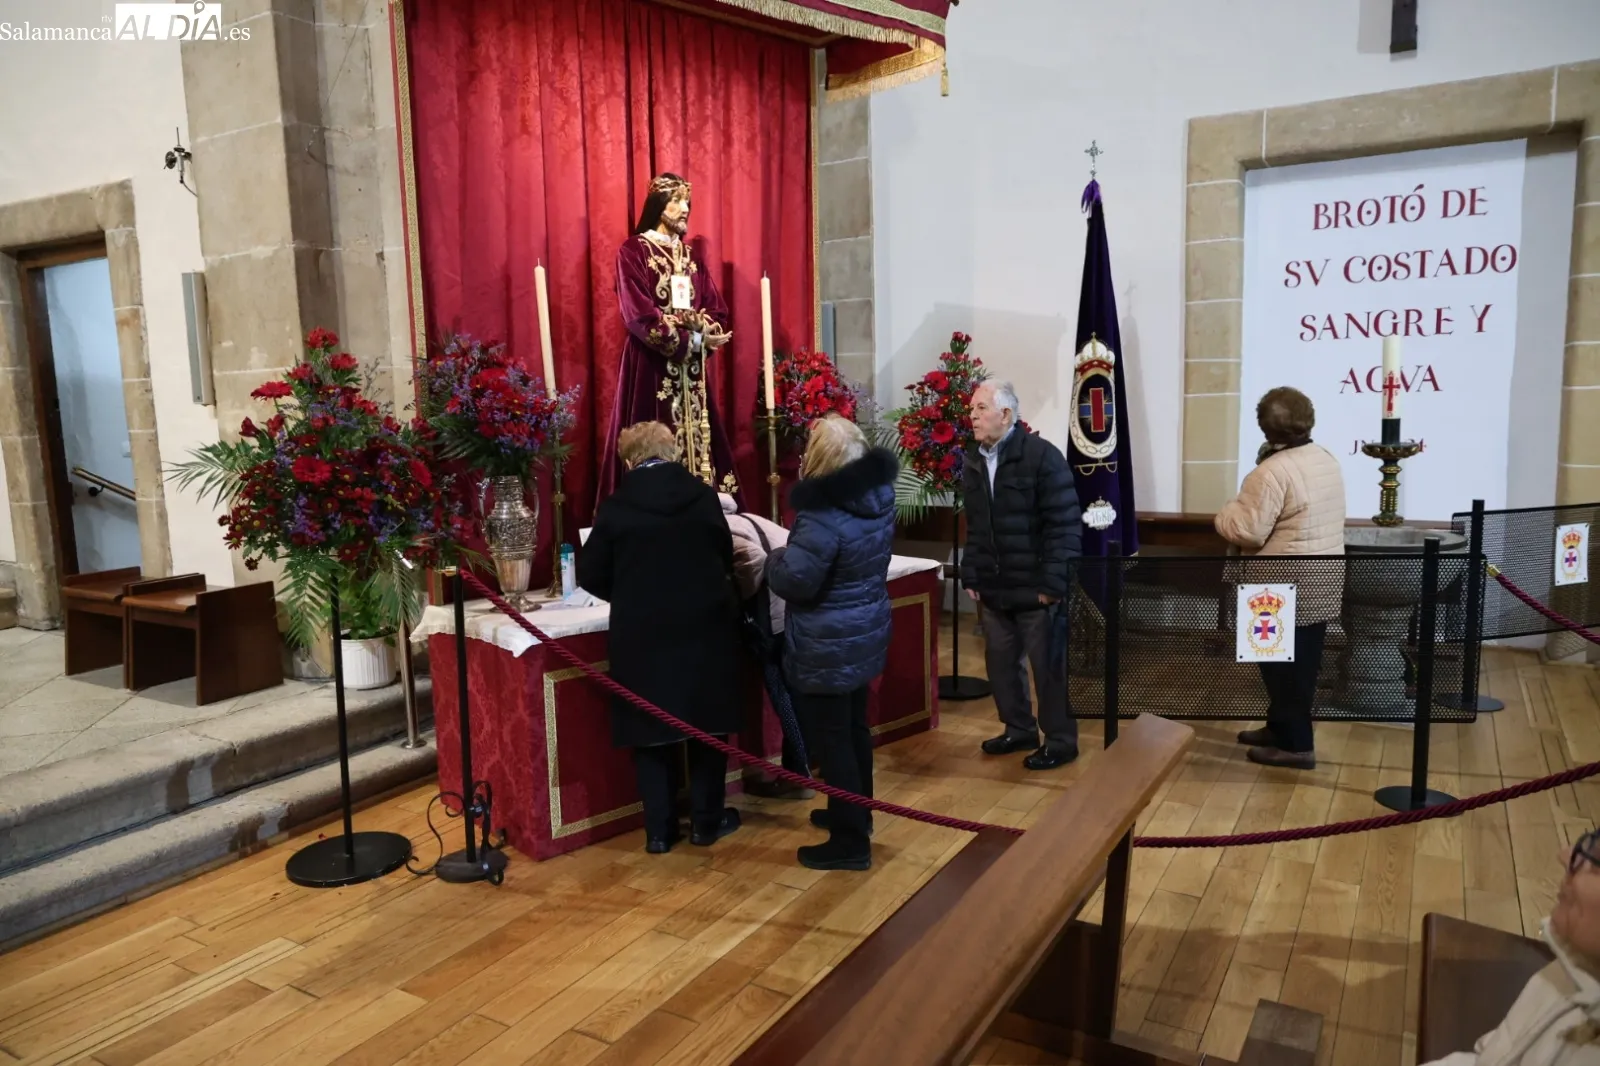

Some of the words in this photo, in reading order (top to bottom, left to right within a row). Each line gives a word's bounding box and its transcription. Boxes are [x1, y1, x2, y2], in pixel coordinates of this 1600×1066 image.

[1312, 184, 1426, 230] BROTÓ
[1440, 186, 1489, 219] DE
[1284, 258, 1331, 288] SV
[1343, 244, 1518, 283] COSTADO
[1299, 305, 1455, 342] SANGRE
[1469, 303, 1493, 333] Y
